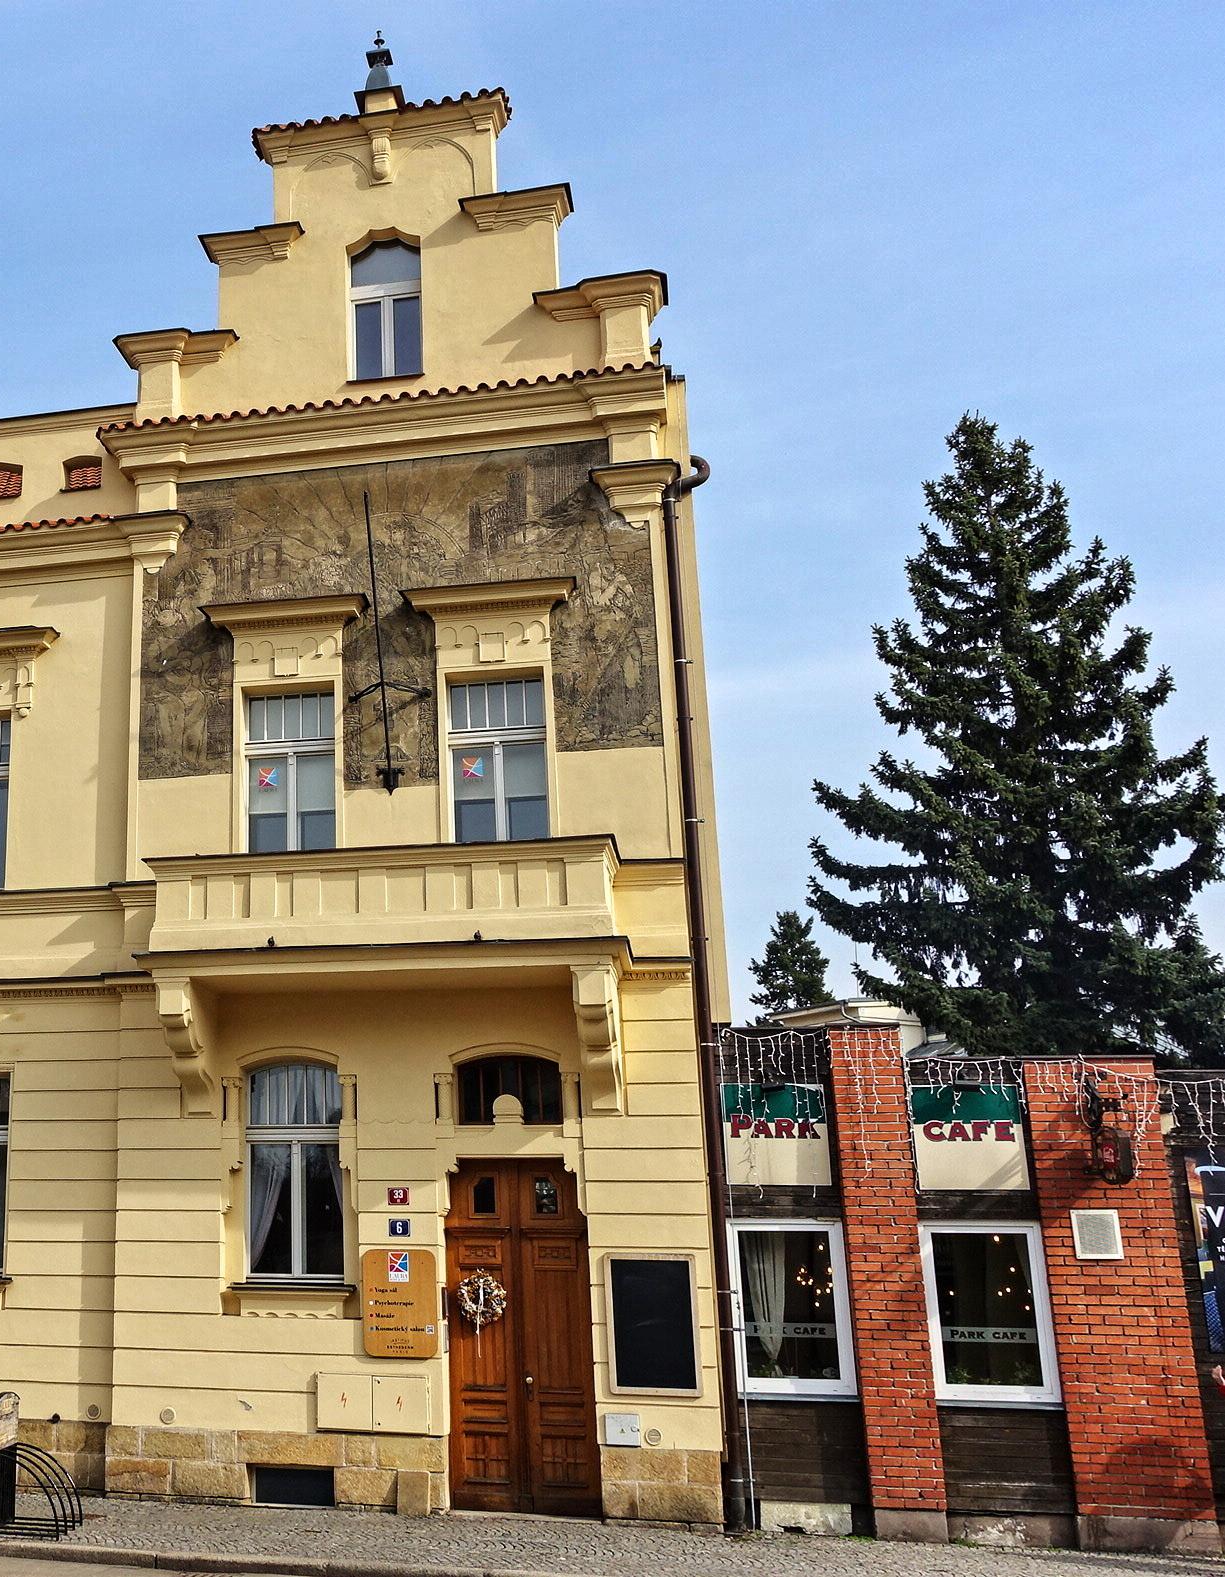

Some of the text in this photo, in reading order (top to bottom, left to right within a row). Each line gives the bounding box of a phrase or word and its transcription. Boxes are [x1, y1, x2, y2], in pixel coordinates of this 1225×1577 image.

[730, 1113, 821, 1139] PARK
[922, 1119, 1017, 1142] CAFE
[393, 1189, 404, 1199] 33
[396, 1221, 403, 1234] 6
[374, 1287, 389, 1295] Yoga
[374, 1300, 414, 1308] Psychoterapie
[375, 1325, 408, 1334] Kosmetický
[793, 1326, 826, 1335] CAFE
[950, 1329, 1027, 1340] PARK CAFE
